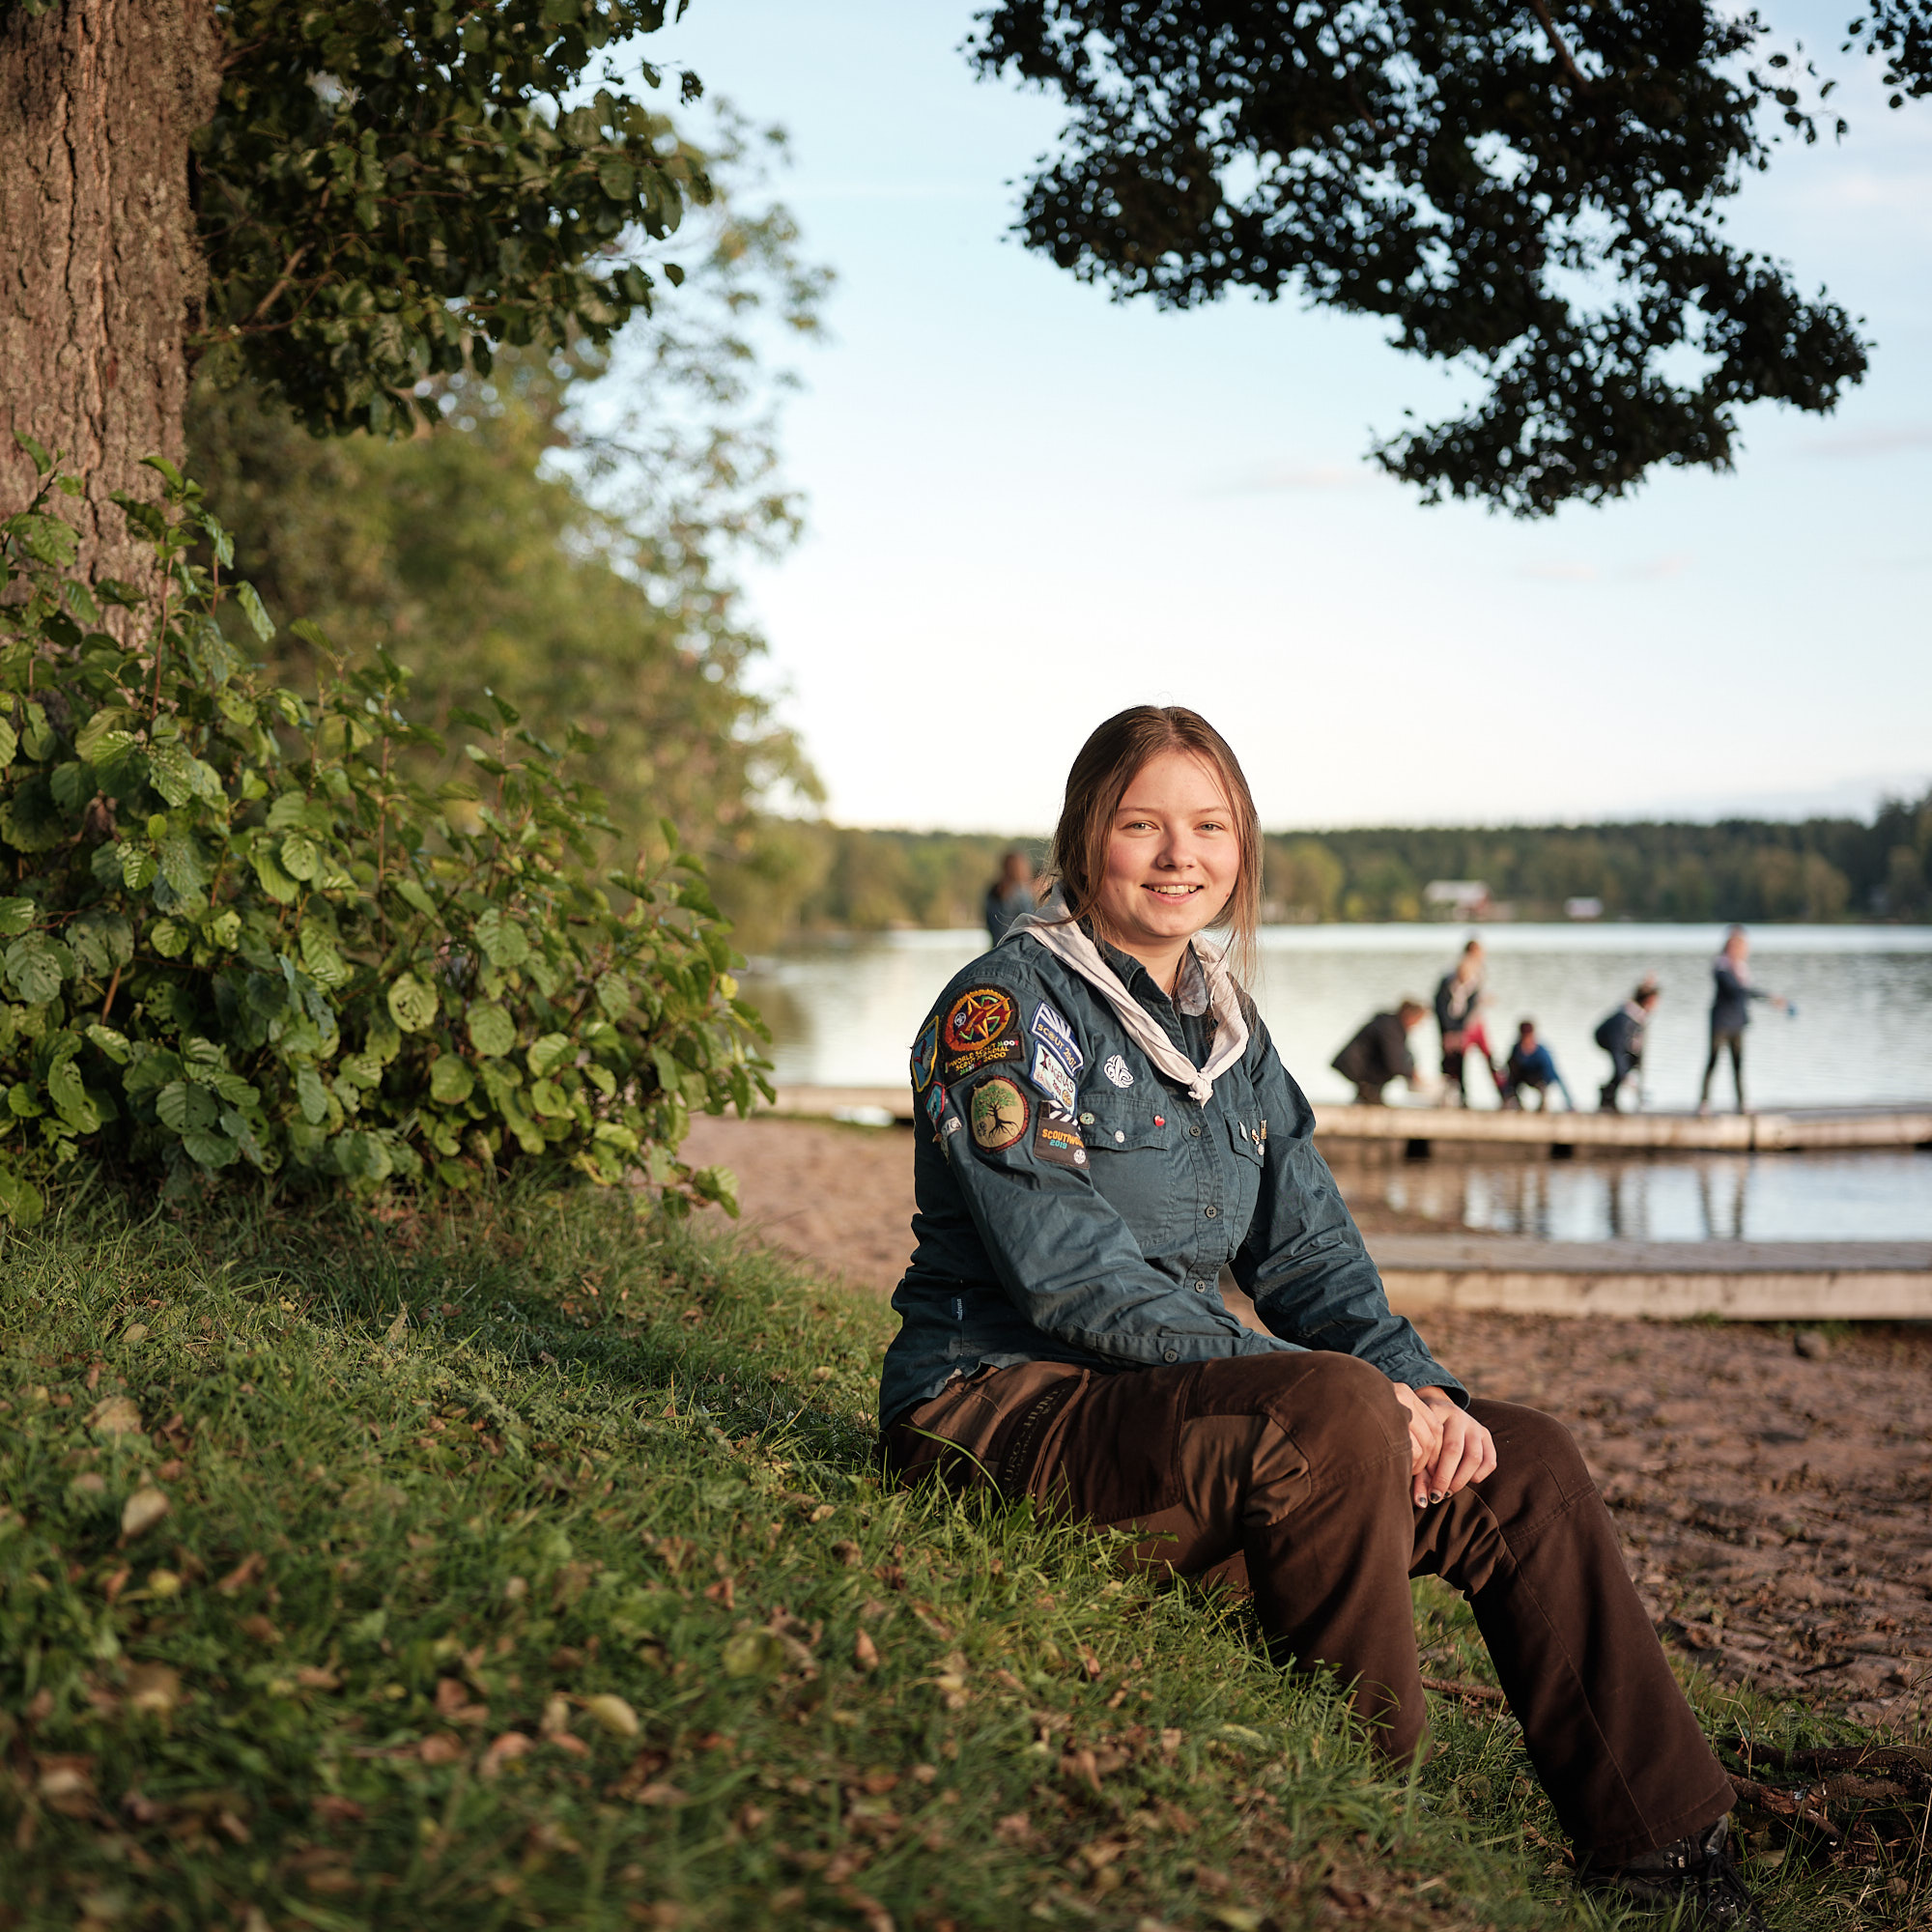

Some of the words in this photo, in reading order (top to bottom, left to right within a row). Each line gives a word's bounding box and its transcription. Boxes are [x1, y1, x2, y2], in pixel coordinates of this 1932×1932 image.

[1037, 1024, 1065, 1049] SCOUT
[951, 1052, 974, 1066] WORLD
[983, 1051, 1007, 1063] 2000
[1049, 1139, 1067, 1150] 2019
